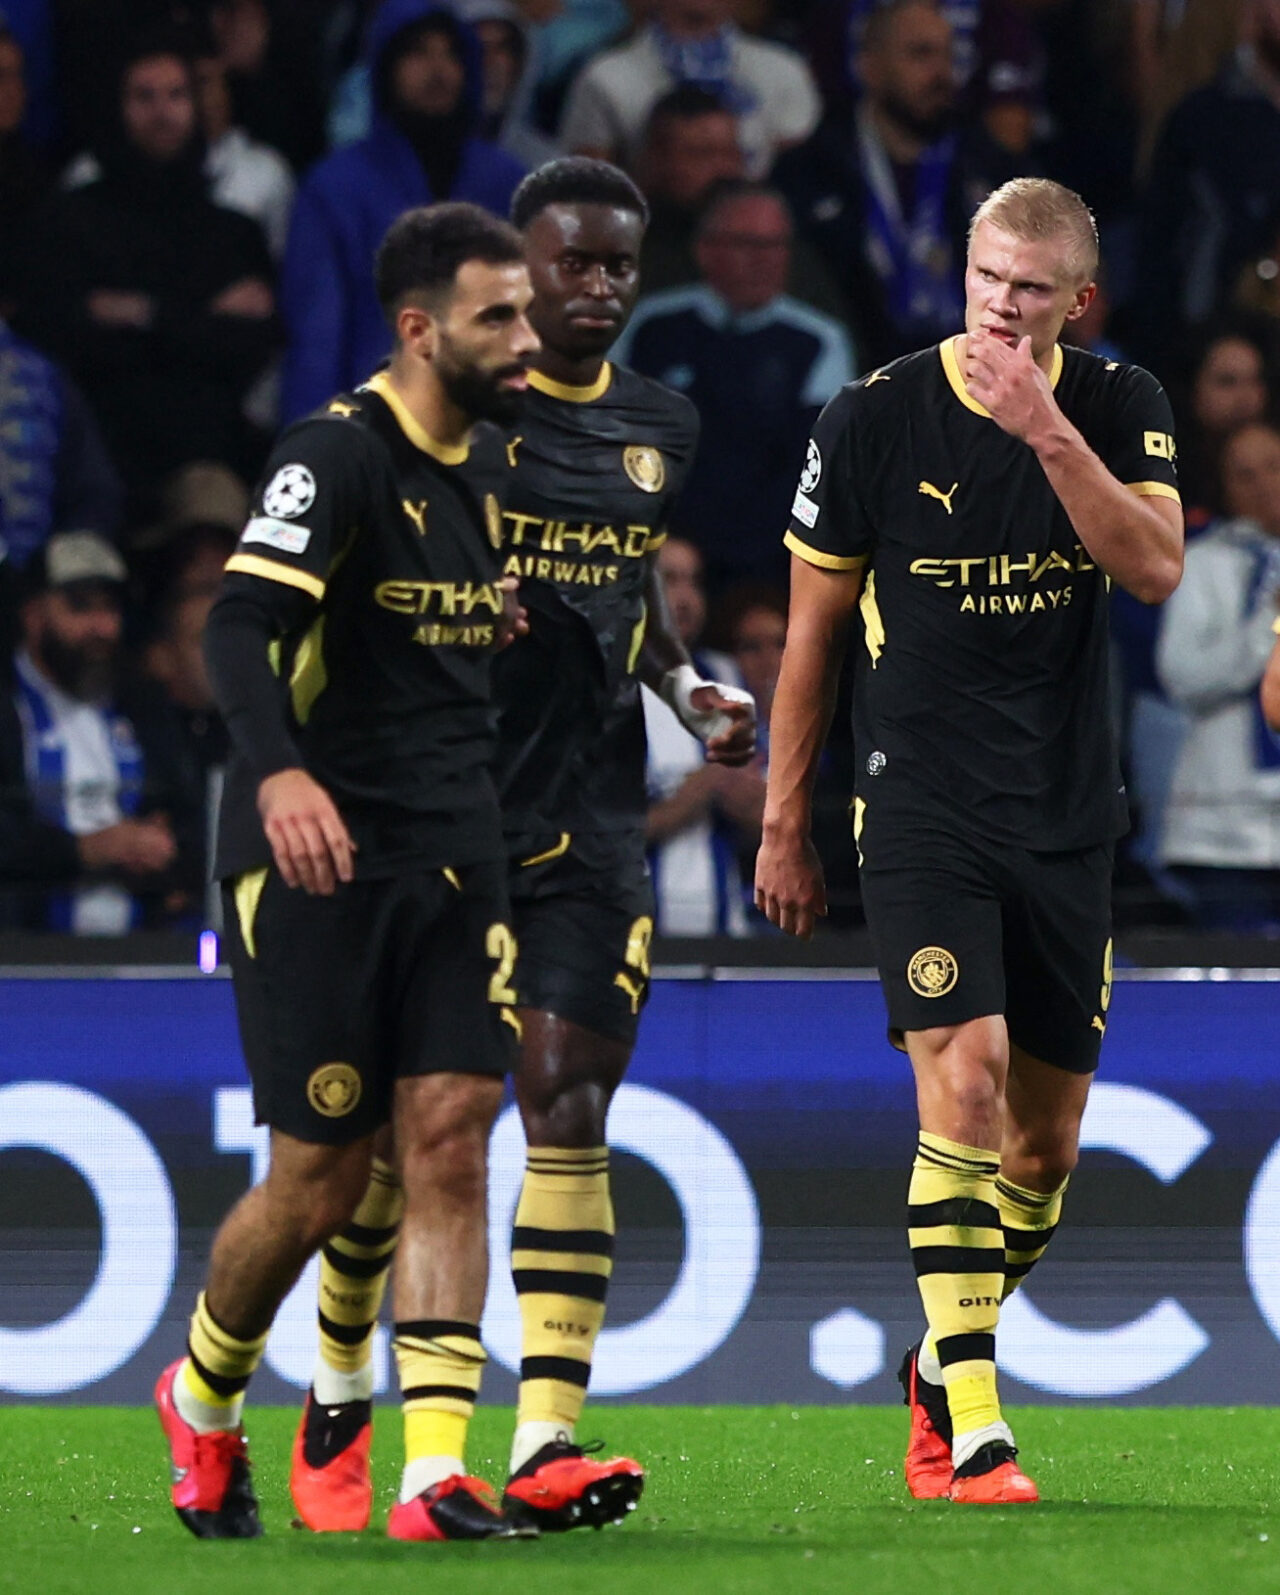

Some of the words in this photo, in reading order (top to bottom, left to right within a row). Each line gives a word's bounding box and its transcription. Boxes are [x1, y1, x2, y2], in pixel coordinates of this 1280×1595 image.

[502, 511, 652, 558] TIHAD
[504, 554, 620, 587] AIRWAYS
[960, 586, 1072, 615] AIRWAYS
